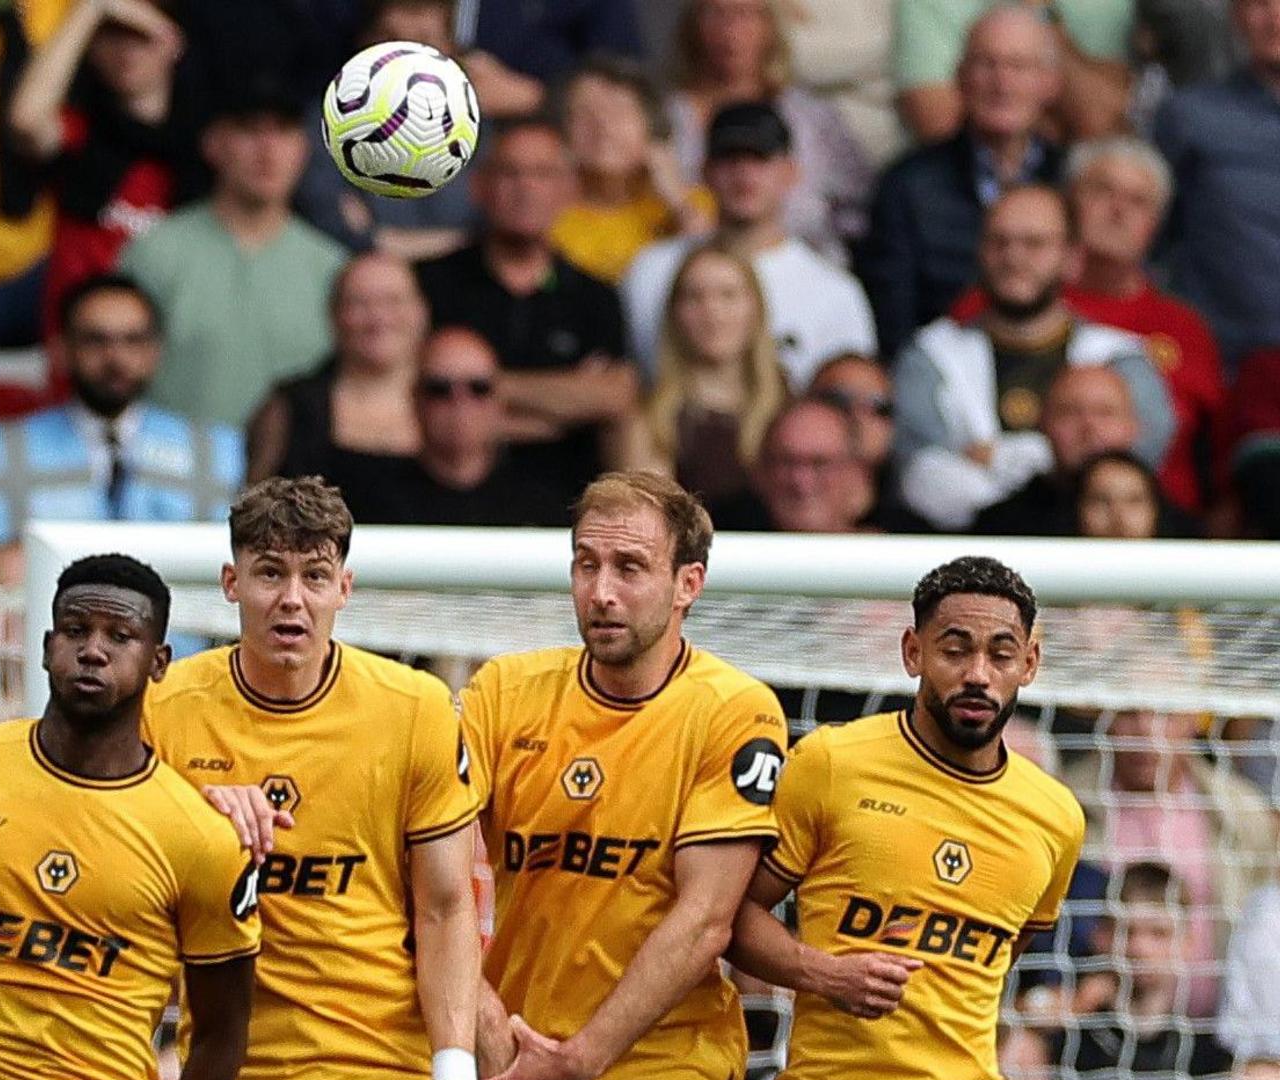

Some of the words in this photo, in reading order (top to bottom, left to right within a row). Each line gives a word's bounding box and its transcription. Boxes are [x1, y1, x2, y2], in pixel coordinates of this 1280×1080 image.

[256, 852, 368, 896] BET
[504, 831, 661, 879] DEBET
[837, 896, 1013, 967] DEBET
